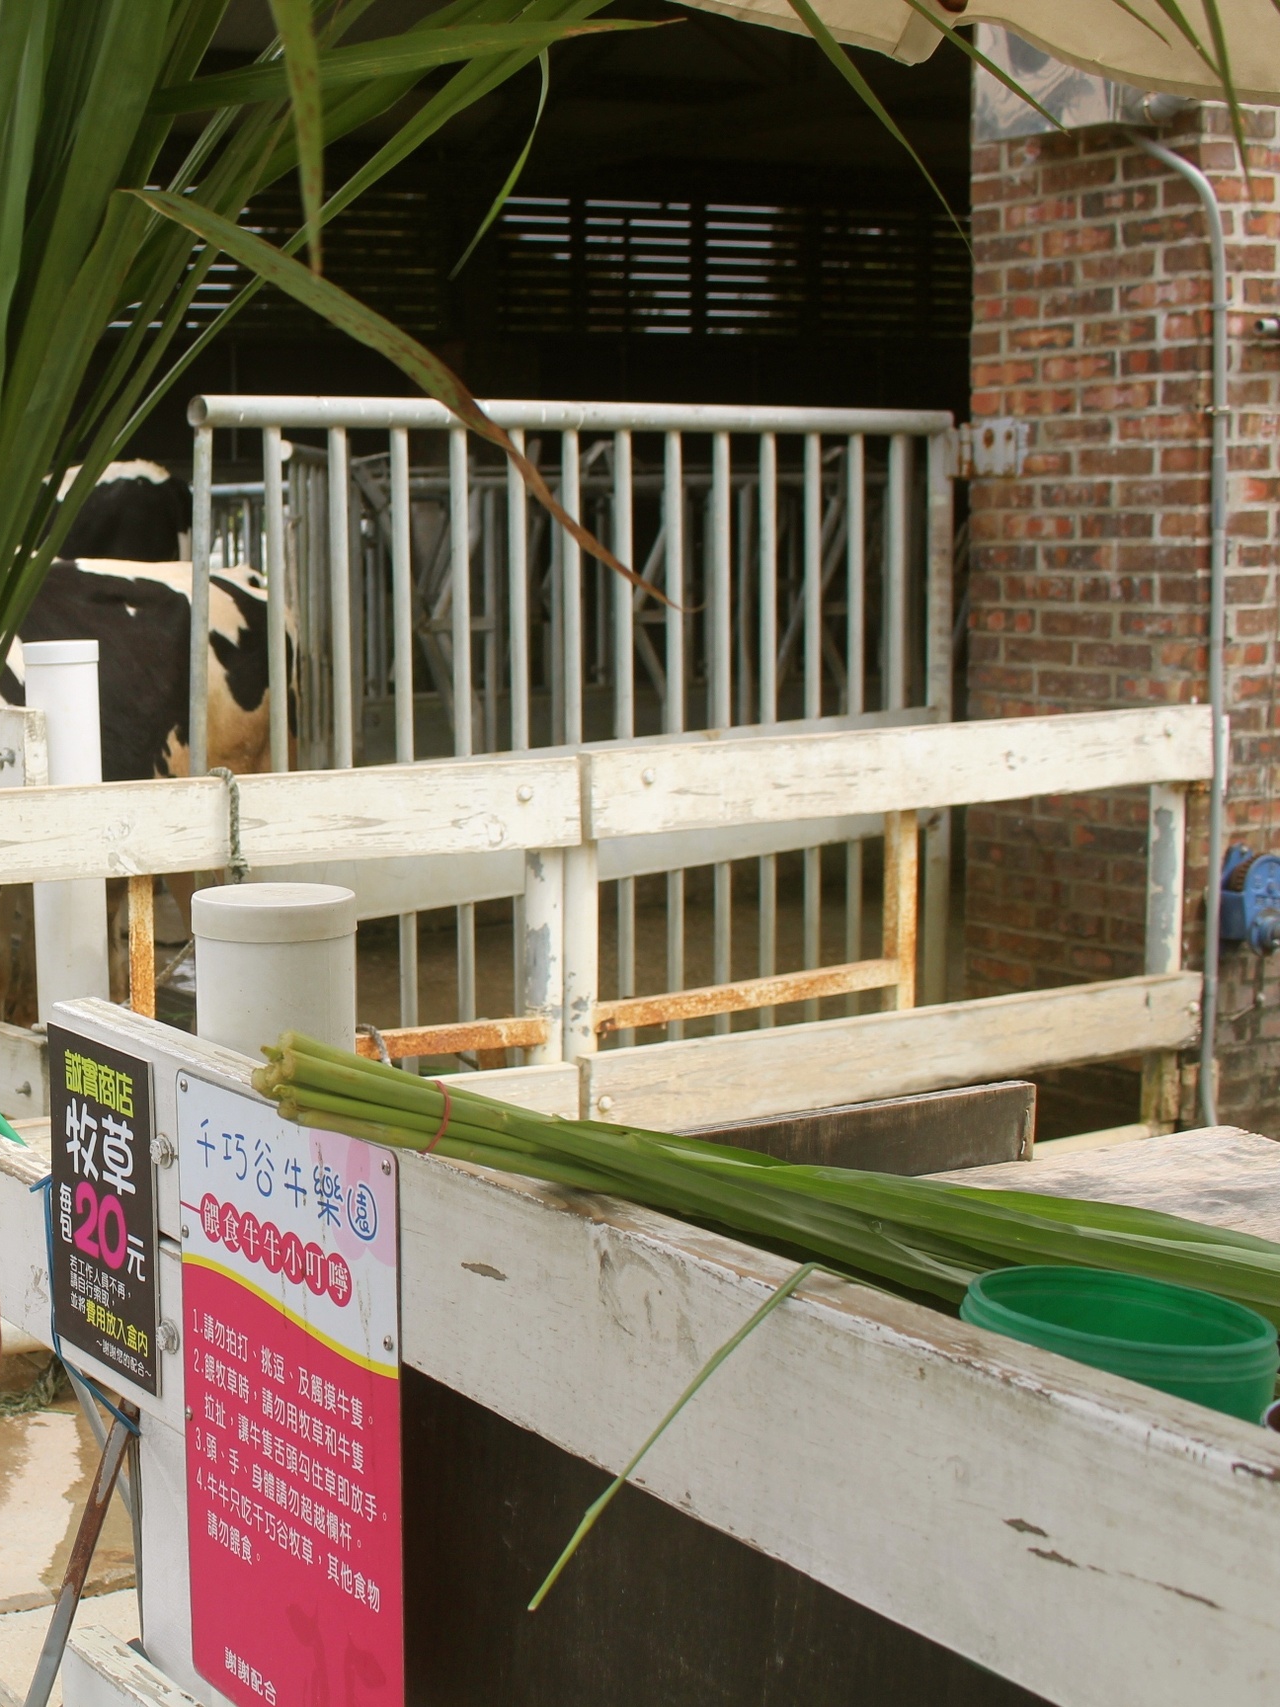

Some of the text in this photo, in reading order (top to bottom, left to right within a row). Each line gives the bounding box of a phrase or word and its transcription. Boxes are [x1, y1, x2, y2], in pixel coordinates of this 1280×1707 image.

[64, 1048, 134, 1119] 誠實商店
[65, 1097, 136, 1196] 牧草
[196, 1118, 378, 1241] 千巧谷牛樂園
[59, 1181, 73, 1244] 每包
[203, 1197, 350, 1301] 餵食牛牛小叮嚀
[224, 1646, 277, 1707] 謝謝配合
